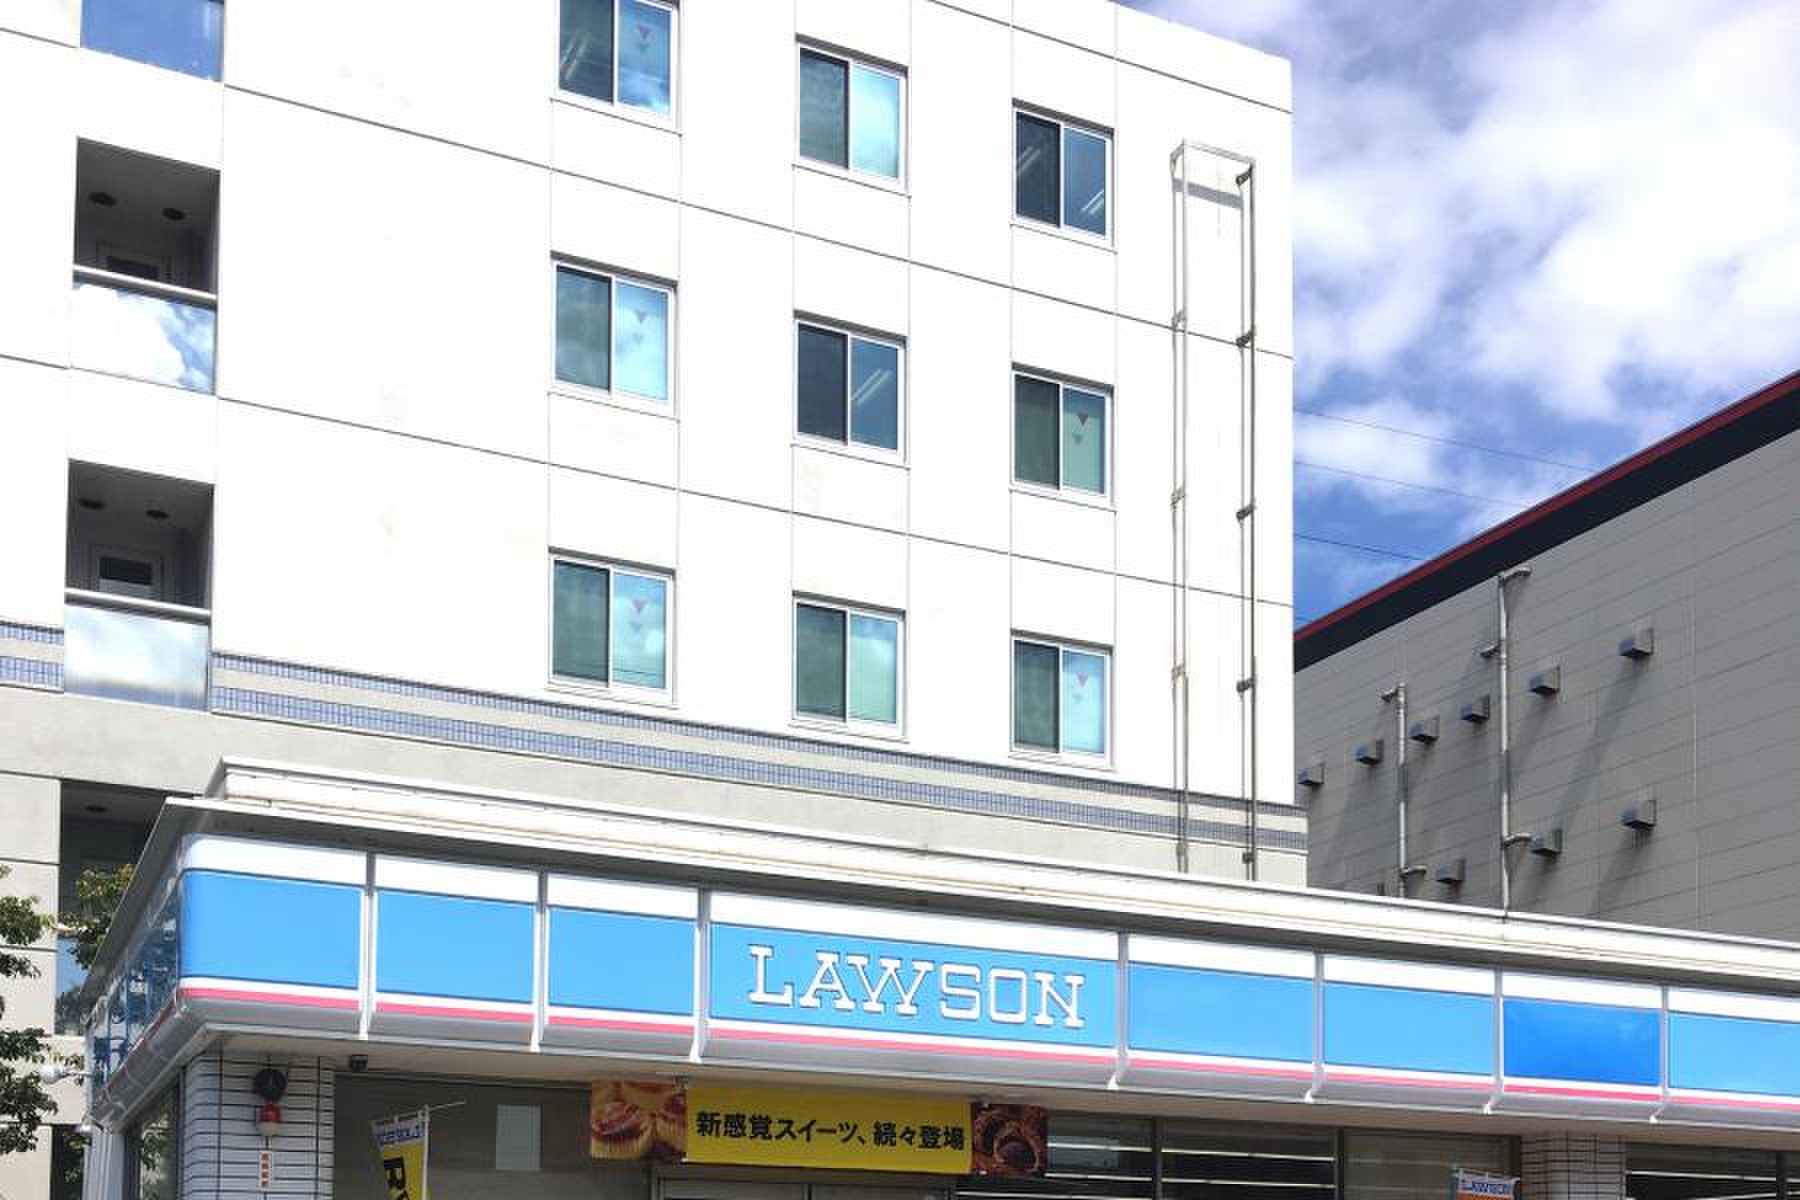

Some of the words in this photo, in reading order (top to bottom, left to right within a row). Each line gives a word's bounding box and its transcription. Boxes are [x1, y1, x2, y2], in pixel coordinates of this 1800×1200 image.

[749, 945, 1084, 1028] LAWSON
[696, 1110, 965, 1150] 新感覚スイーツ、続々登場
